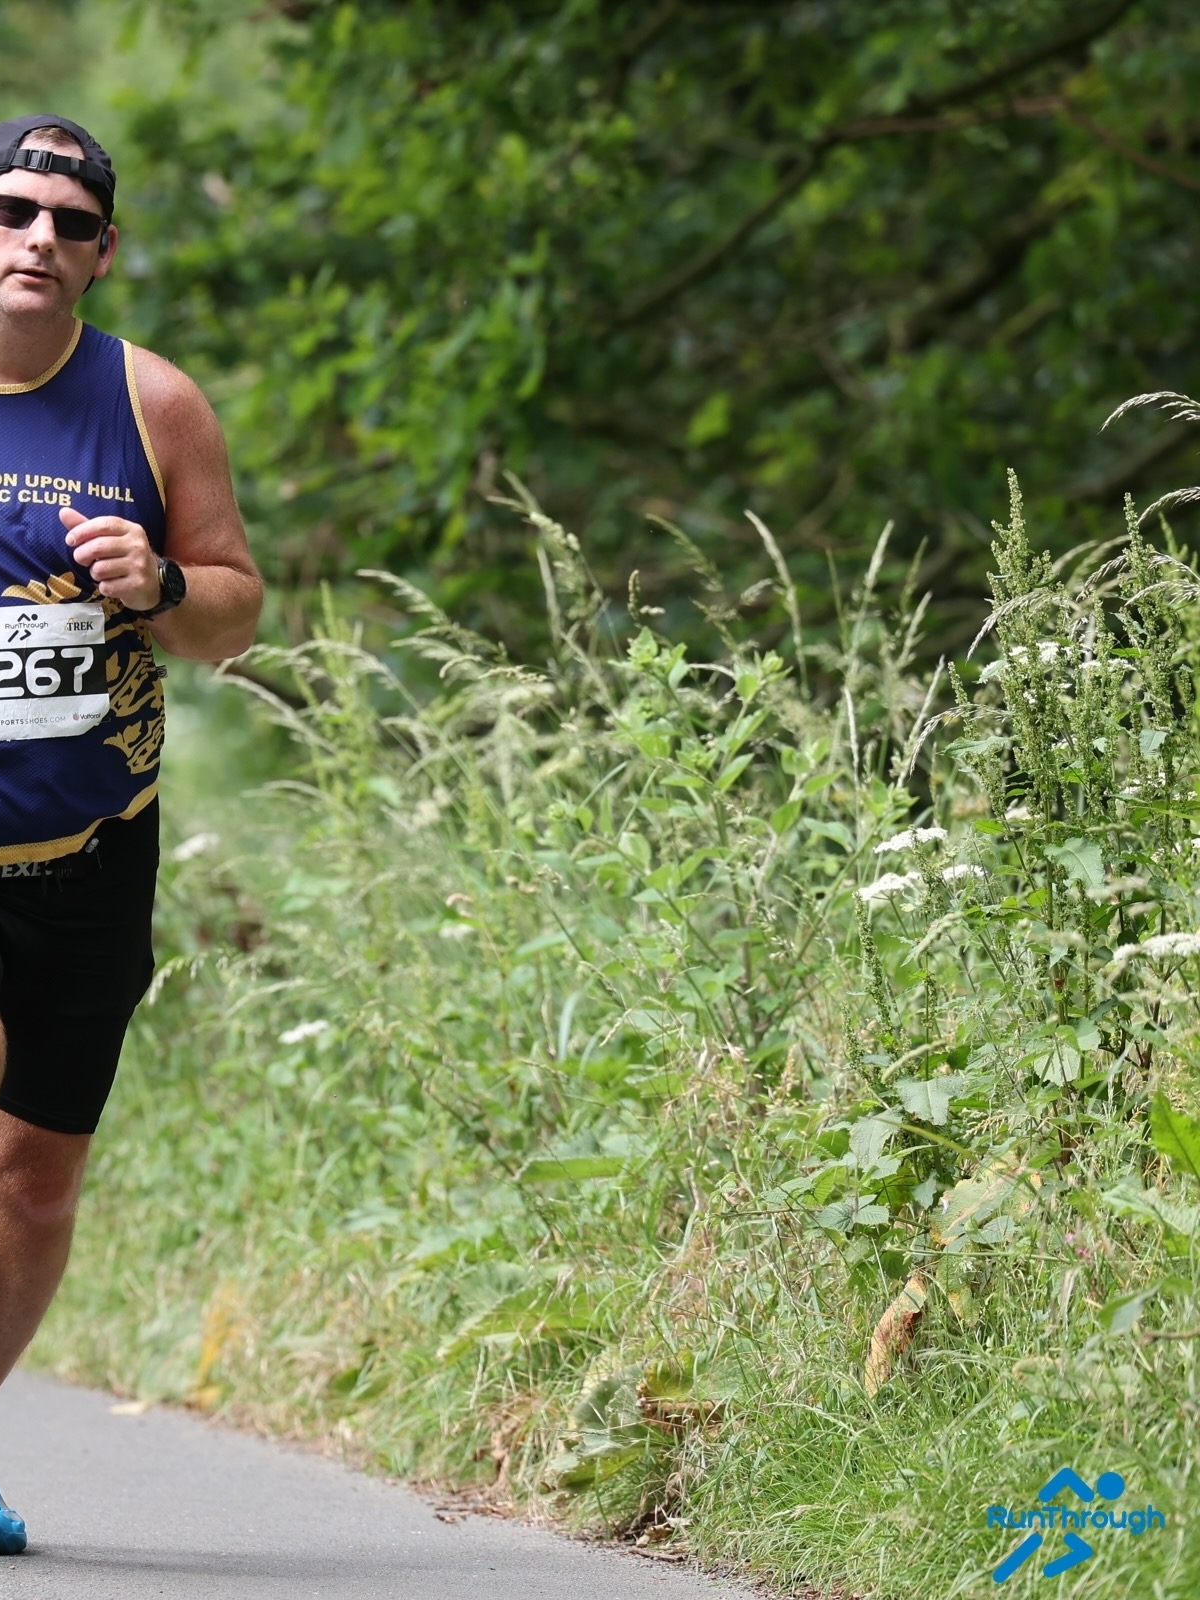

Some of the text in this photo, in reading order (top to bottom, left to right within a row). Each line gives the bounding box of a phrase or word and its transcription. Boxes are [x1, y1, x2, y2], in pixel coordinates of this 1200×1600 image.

[25, 474, 81, 493] UPON
[87, 483, 135, 503] HULL
[17, 489, 72, 506] CLUB
[5, 621, 49, 630] RunThrough
[66, 621, 94, 632] TREK
